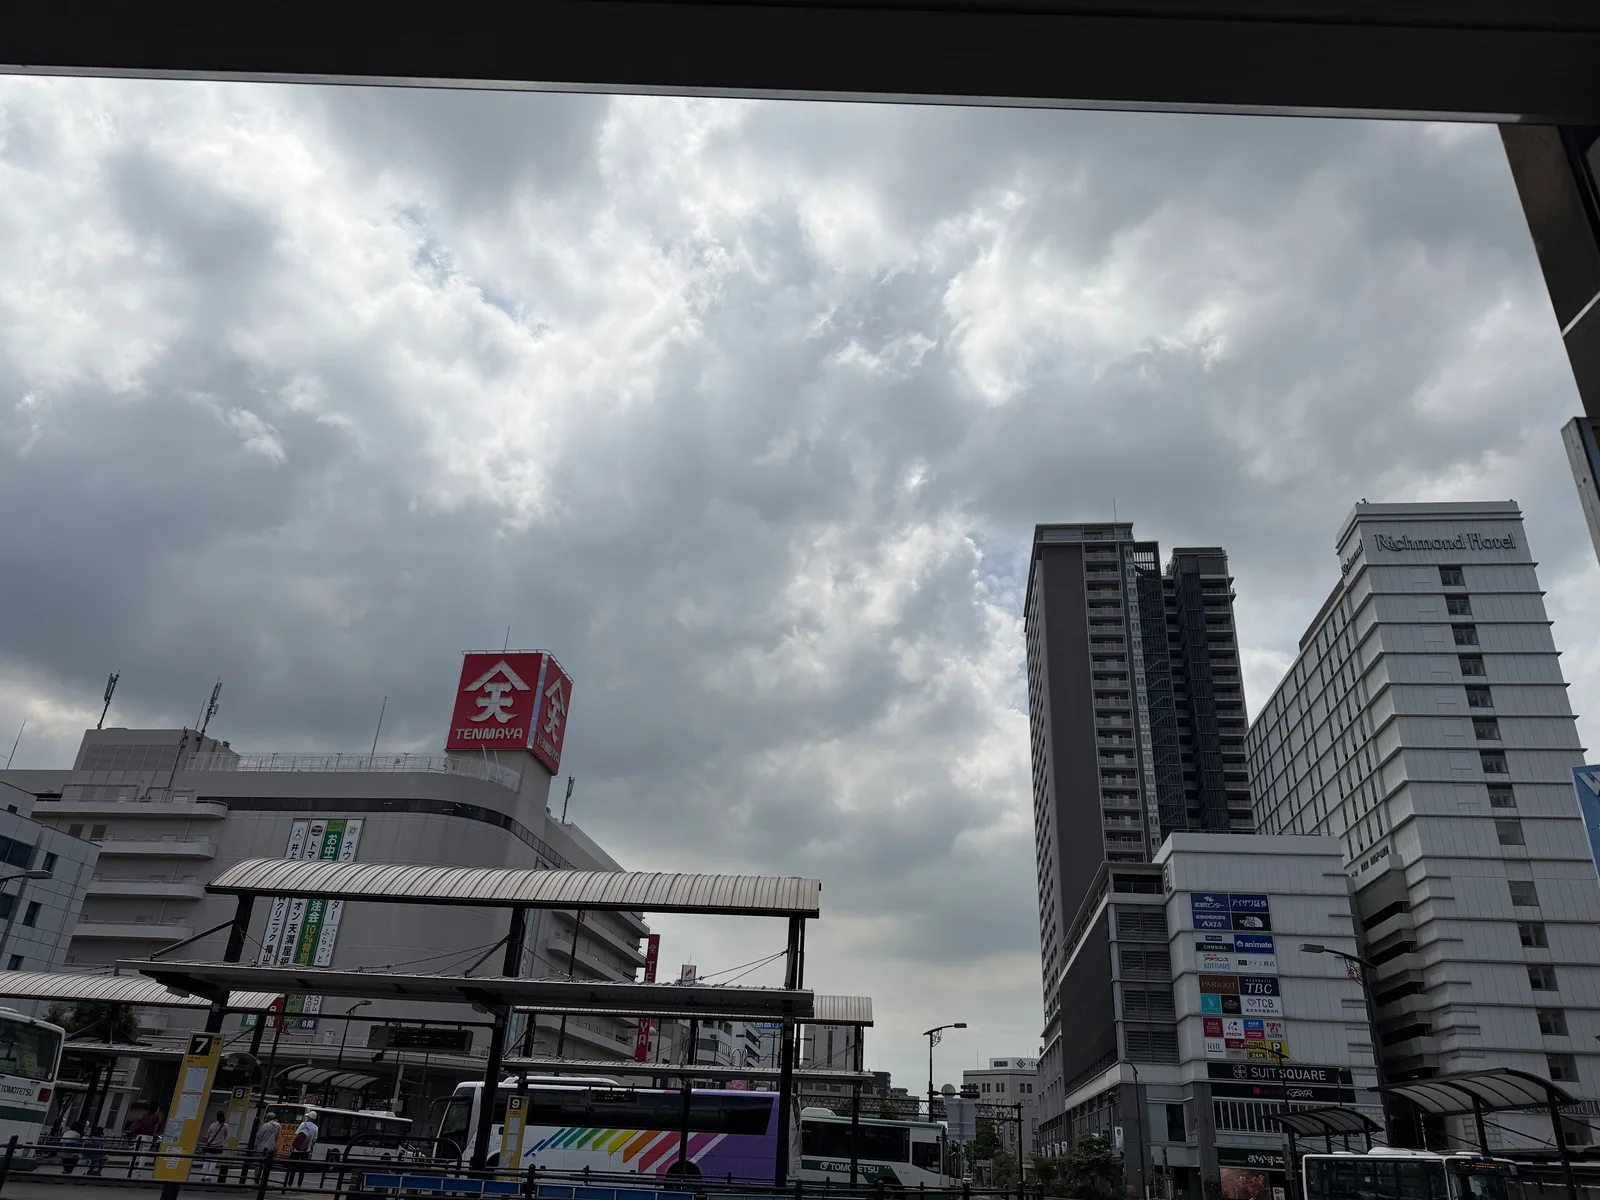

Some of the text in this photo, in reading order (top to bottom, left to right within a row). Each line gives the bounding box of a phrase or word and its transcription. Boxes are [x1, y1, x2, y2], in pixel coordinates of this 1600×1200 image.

[1374, 533, 1517, 551] Richmond Hotel
[455, 728, 523, 741] TENMAYA
[289, 843, 299, 860] 井上
[308, 841, 317, 859] トマ
[343, 841, 354, 861] ネウ
[1201, 920, 1223, 928] Axis
[1245, 941, 1273, 949] animate
[1204, 962, 1231, 970] ADERANS
[1201, 981, 1237, 989] PARIGOT
[1245, 983, 1273, 995] TBC
[1256, 998, 1274, 1008] TCB
[195, 1037, 210, 1053] 7
[1251, 1068, 1326, 1081] SUIT SQUARE
[1, 1085, 34, 1096] TOMOTETSU
[235, 1089, 243, 1099] 8
[512, 1099, 521, 1110] 9
